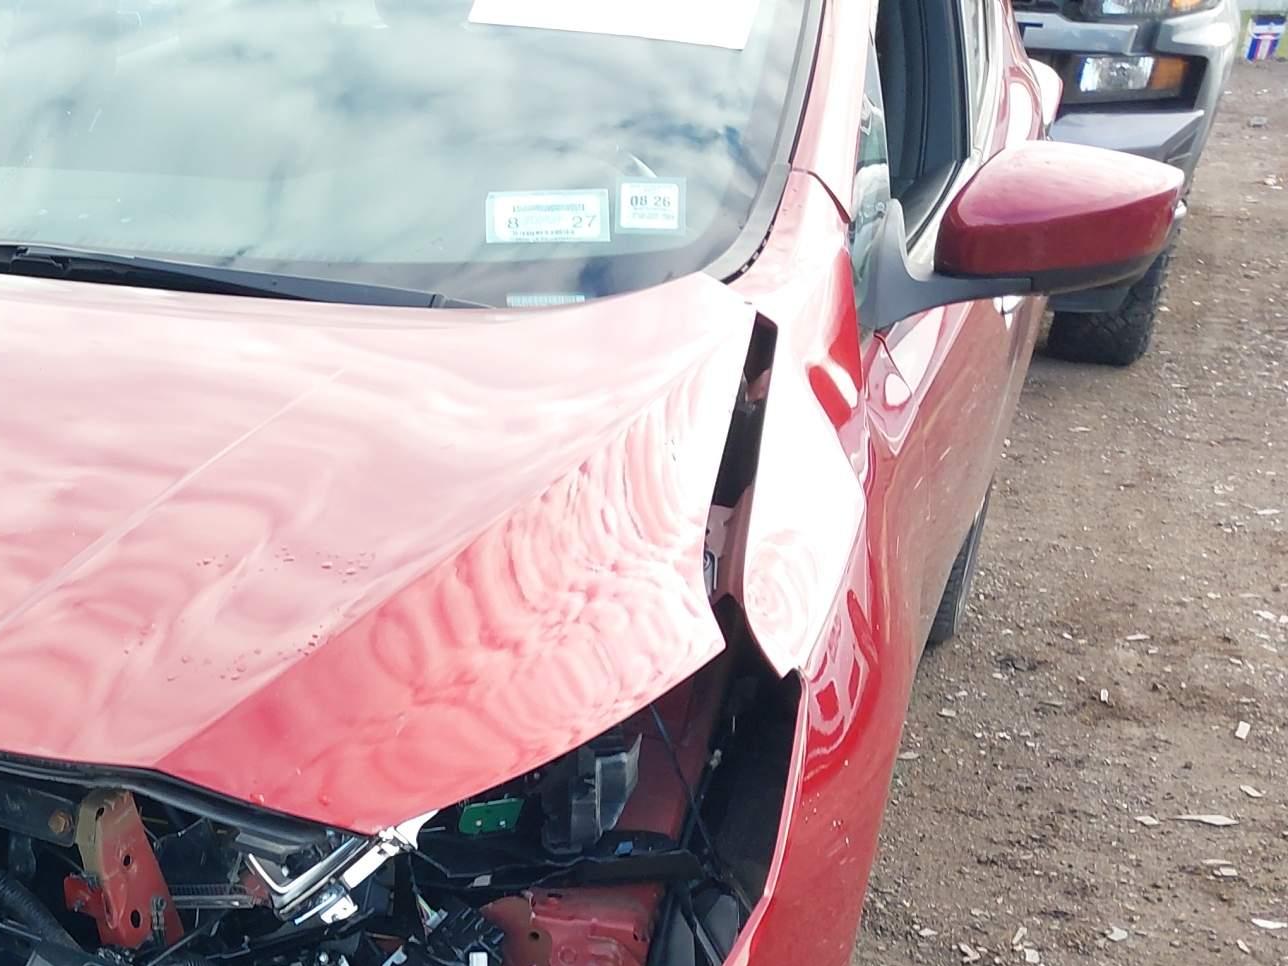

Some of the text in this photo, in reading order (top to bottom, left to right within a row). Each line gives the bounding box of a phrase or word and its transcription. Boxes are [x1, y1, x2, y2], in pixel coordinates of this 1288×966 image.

[630, 195, 671, 207] 08 26
[507, 215, 597, 229] 8 27
